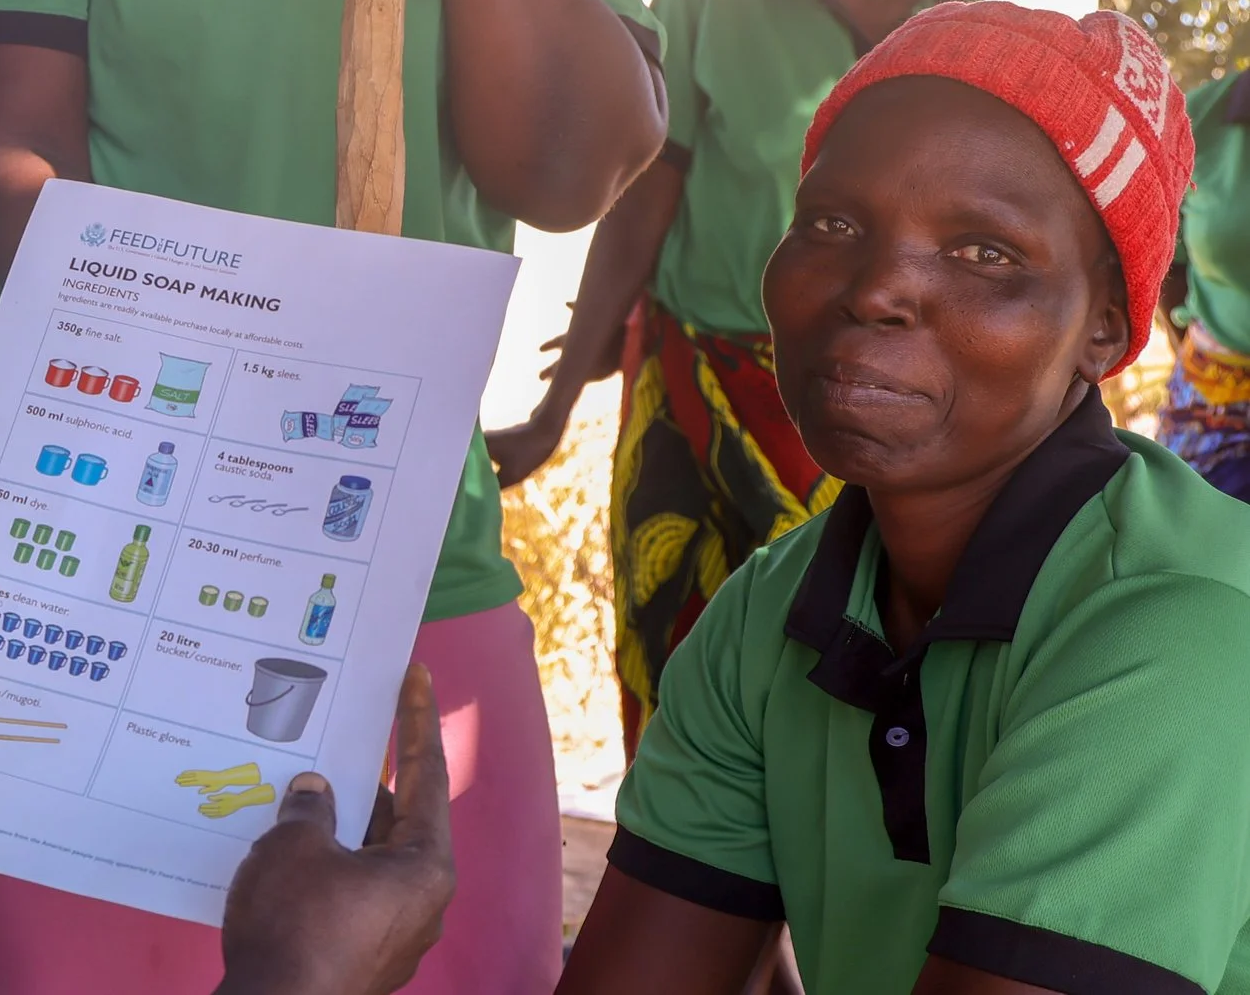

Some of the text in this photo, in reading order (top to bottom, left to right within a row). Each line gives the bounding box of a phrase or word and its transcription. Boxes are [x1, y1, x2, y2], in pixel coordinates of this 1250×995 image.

[110, 229, 157, 250] FEED
[164, 240, 243, 269] FUTURE
[62, 278, 140, 302] INGREDIENTS
[69, 257, 282, 312] LIQUID SOAP MAKING
[58, 292, 98, 308] Ingredients
[99, 301, 112, 310] are
[114, 302, 138, 317] readily
[140, 308, 172, 324] available
[174, 318, 208, 332] purchase
[209, 325, 232, 338] locally
[244, 332, 282, 346] affordable
[57, 320, 122, 343] 350g fine salt.
[242, 362, 302, 380] 1.5 kg slees.
[160, 388, 190, 401] SALT
[338, 402, 356, 413] SLE
[26, 405, 134, 440] 500 ml sulphonic acid.
[214, 462, 246, 476] caustic
[218, 451, 294, 474] 4 tablespoons
[12, 494, 28, 505] ml
[188, 538, 284, 568] 20-30 ml perfume.
[12, 592, 38, 606] clean
[40, 602, 70, 616] water.
[160, 630, 201, 649] 20 litre
[156, 642, 242, 672] bucket/container.
[126, 722, 158, 738] Plastic
